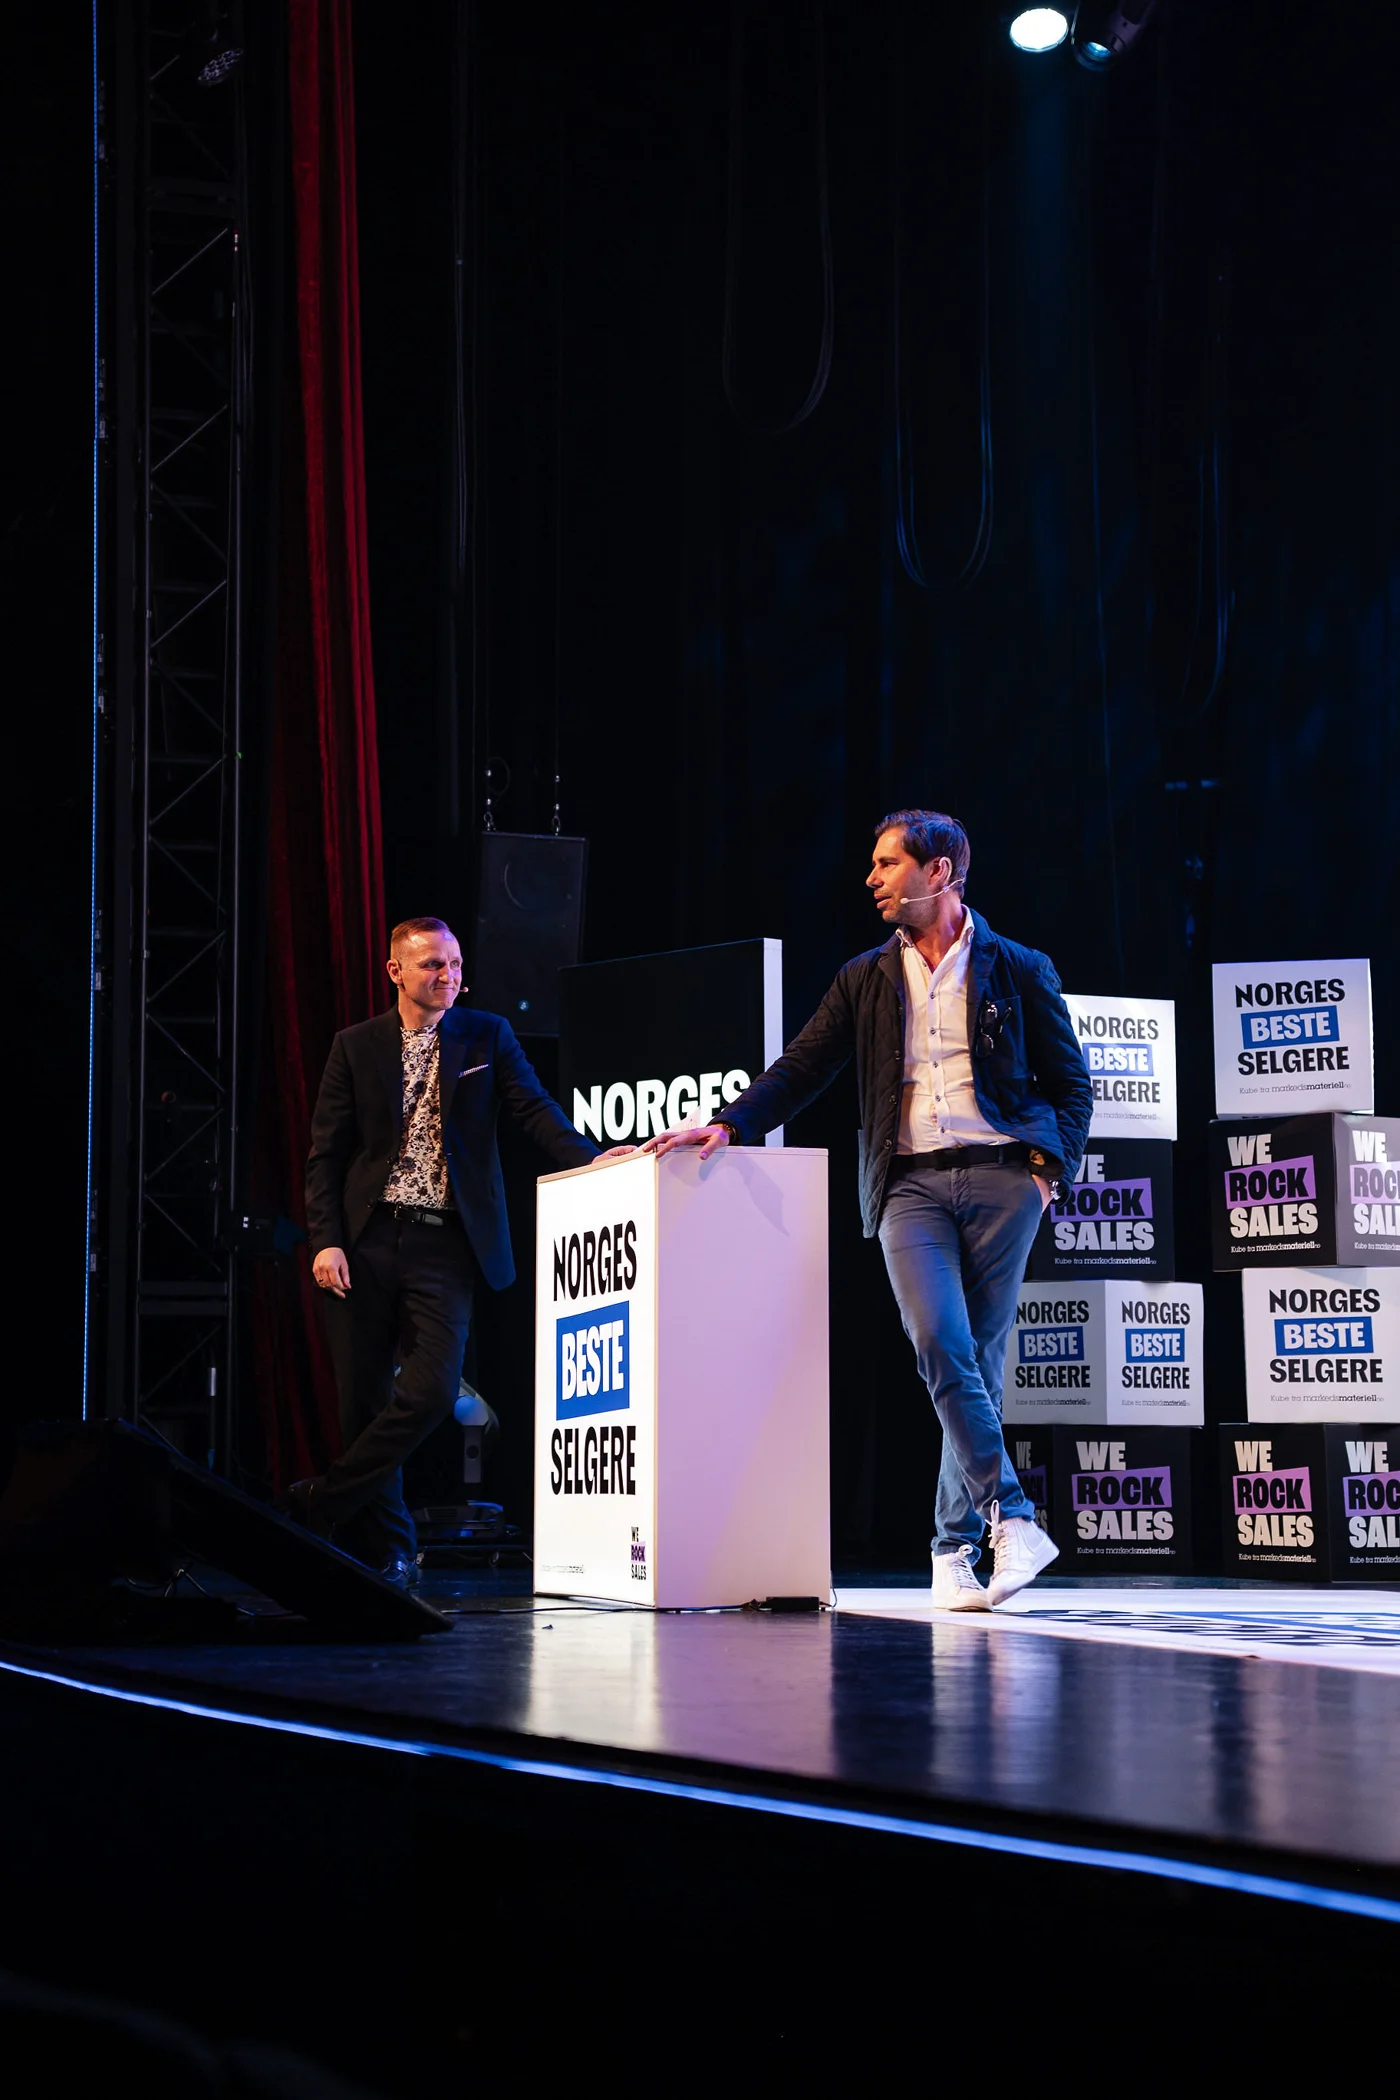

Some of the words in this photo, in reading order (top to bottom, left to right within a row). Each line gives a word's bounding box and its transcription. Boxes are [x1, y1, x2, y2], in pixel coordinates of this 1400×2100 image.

[1235, 978, 1345, 1008] NORGES
[1078, 1015, 1159, 1040] NORGES
[1250, 1011, 1331, 1043] BESTE
[1088, 1047, 1149, 1072] BESTE
[1237, 1046, 1350, 1076] SELGERE
[1092, 1079, 1160, 1103] ELGERE
[1228, 1133, 1272, 1166] WE
[1352, 1130, 1388, 1163] WE
[1229, 1167, 1309, 1202] ROCK
[1354, 1167, 1400, 1200] ROC
[1054, 1188, 1146, 1216] ROCK
[1230, 1202, 1318, 1239] SALES
[1054, 1221, 1155, 1251] SALES
[553, 1220, 638, 1302] NORGES
[1055, 1257, 1072, 1265] Kube
[1016, 1300, 1090, 1325] NORGES
[1121, 1301, 1191, 1326] NORGES
[1269, 1289, 1381, 1313] NORGES
[1024, 1331, 1079, 1357] BESTE
[1130, 1333, 1181, 1357] BESTE
[1283, 1322, 1366, 1350] BESTE
[561, 1319, 625, 1401] BESTE
[1269, 1358, 1384, 1383] SELGERE
[1015, 1365, 1091, 1389] SELGERE
[1121, 1365, 1191, 1390] SELGERE
[551, 1425, 636, 1496] SELGERE
[1015, 1441, 1032, 1470] WE
[1076, 1441, 1126, 1471] WE
[1234, 1440, 1273, 1472] WE
[1345, 1441, 1389, 1473] WE
[1077, 1476, 1165, 1505] ROCK
[1236, 1477, 1306, 1509] ROCK
[1077, 1510, 1174, 1541] SALES
[1237, 1514, 1315, 1548] SALES
[1348, 1515, 1400, 1549] SAL
[630, 1544, 646, 1563] ROCK
[1077, 1546, 1094, 1554] Kube
[630, 1563, 647, 1581] SALES
